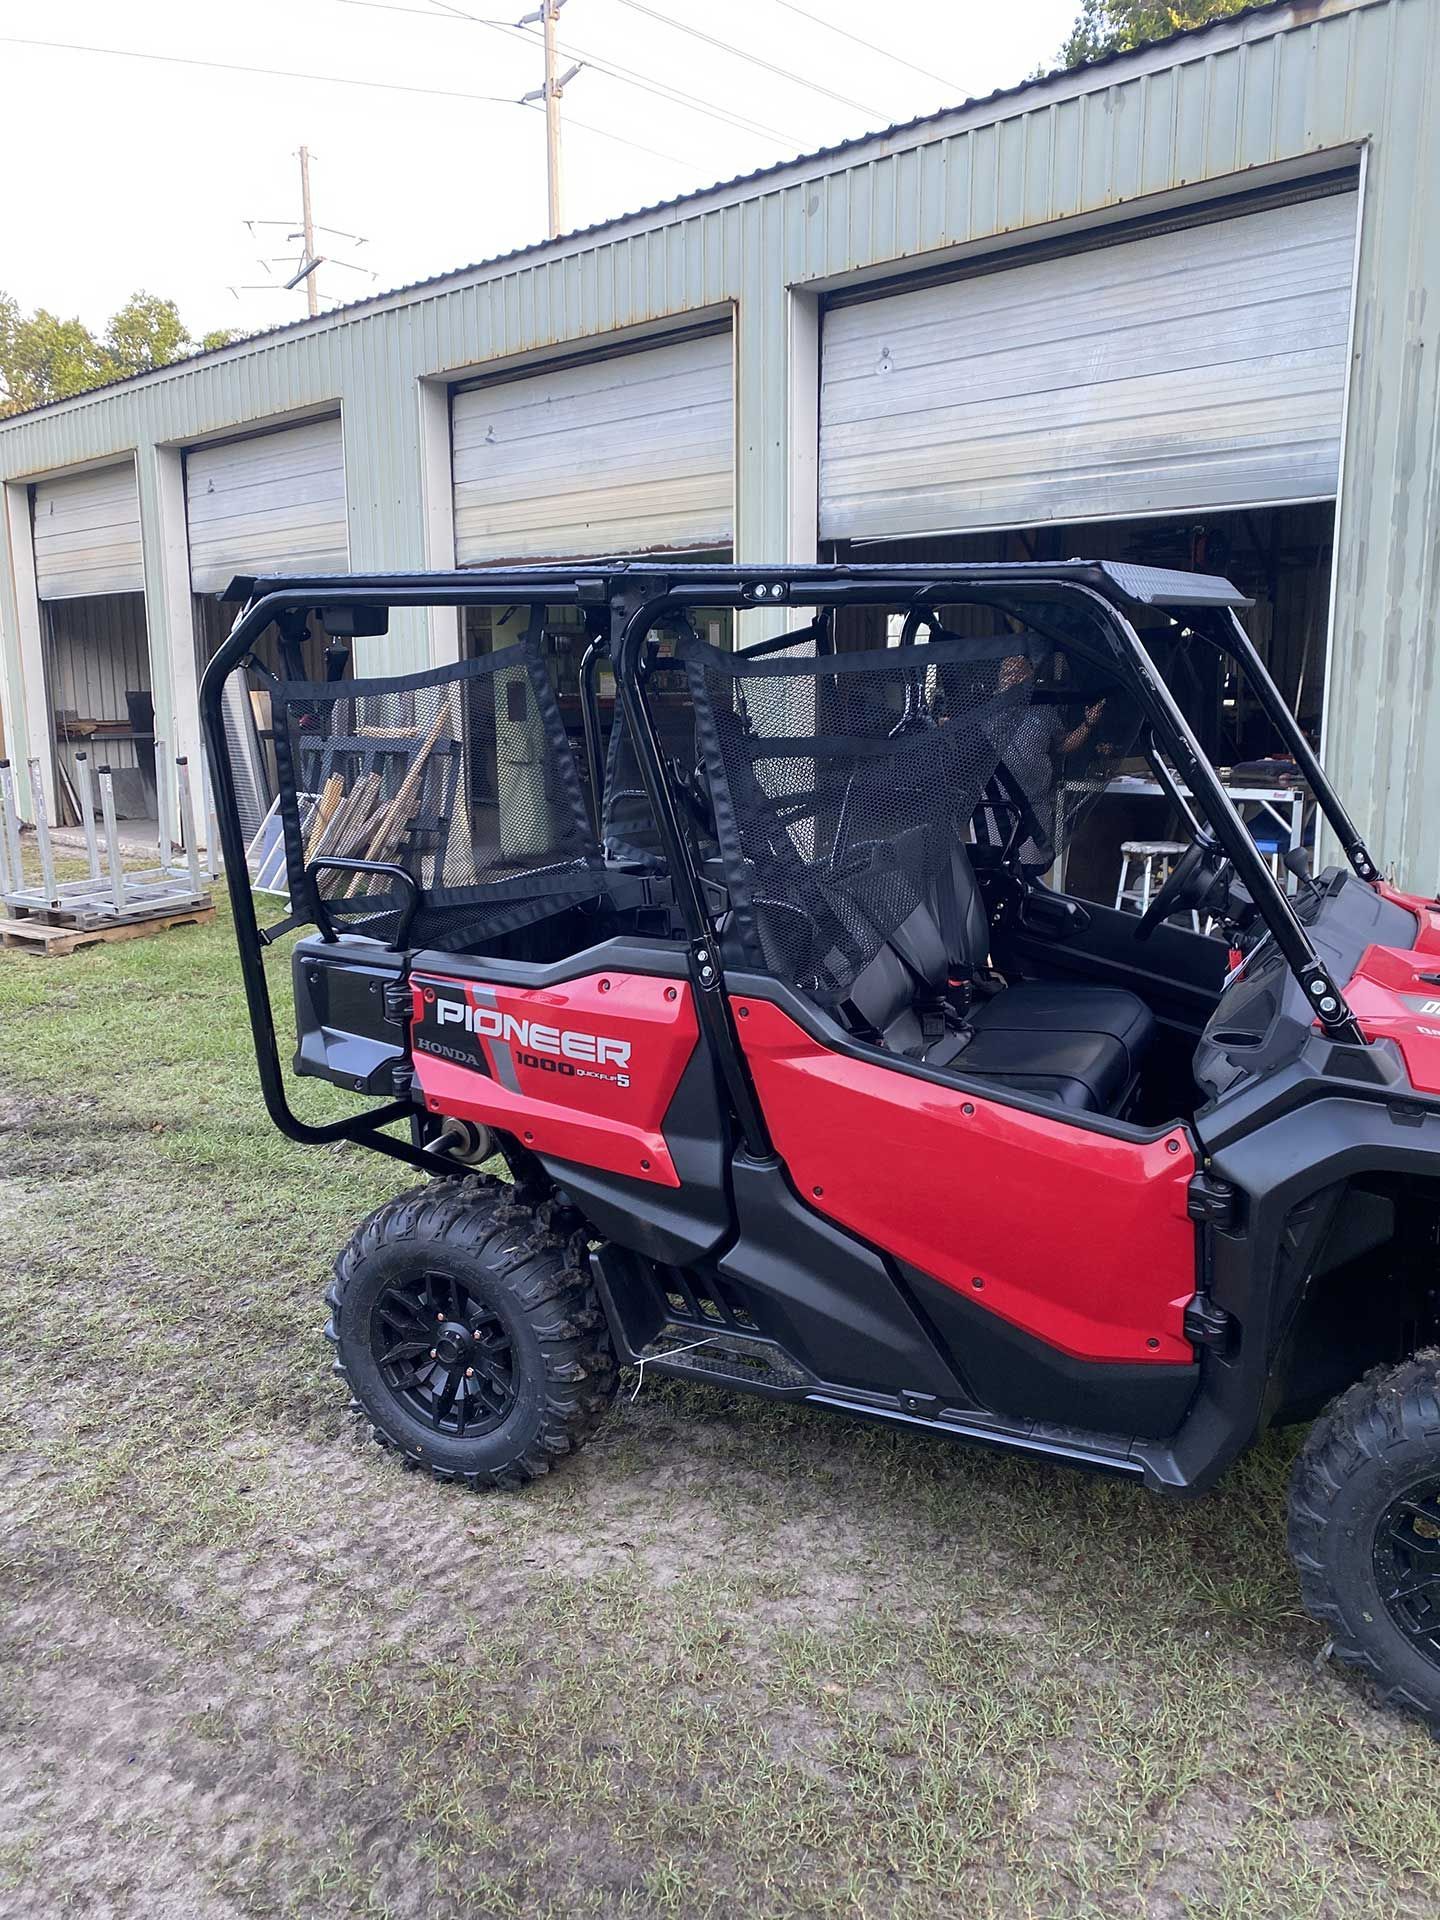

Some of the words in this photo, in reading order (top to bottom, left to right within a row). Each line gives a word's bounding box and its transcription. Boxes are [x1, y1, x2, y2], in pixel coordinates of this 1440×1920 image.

[437, 998, 631, 1068] PIONEER
[417, 1038, 480, 1068] HONDA
[516, 1051, 575, 1076] 1000
